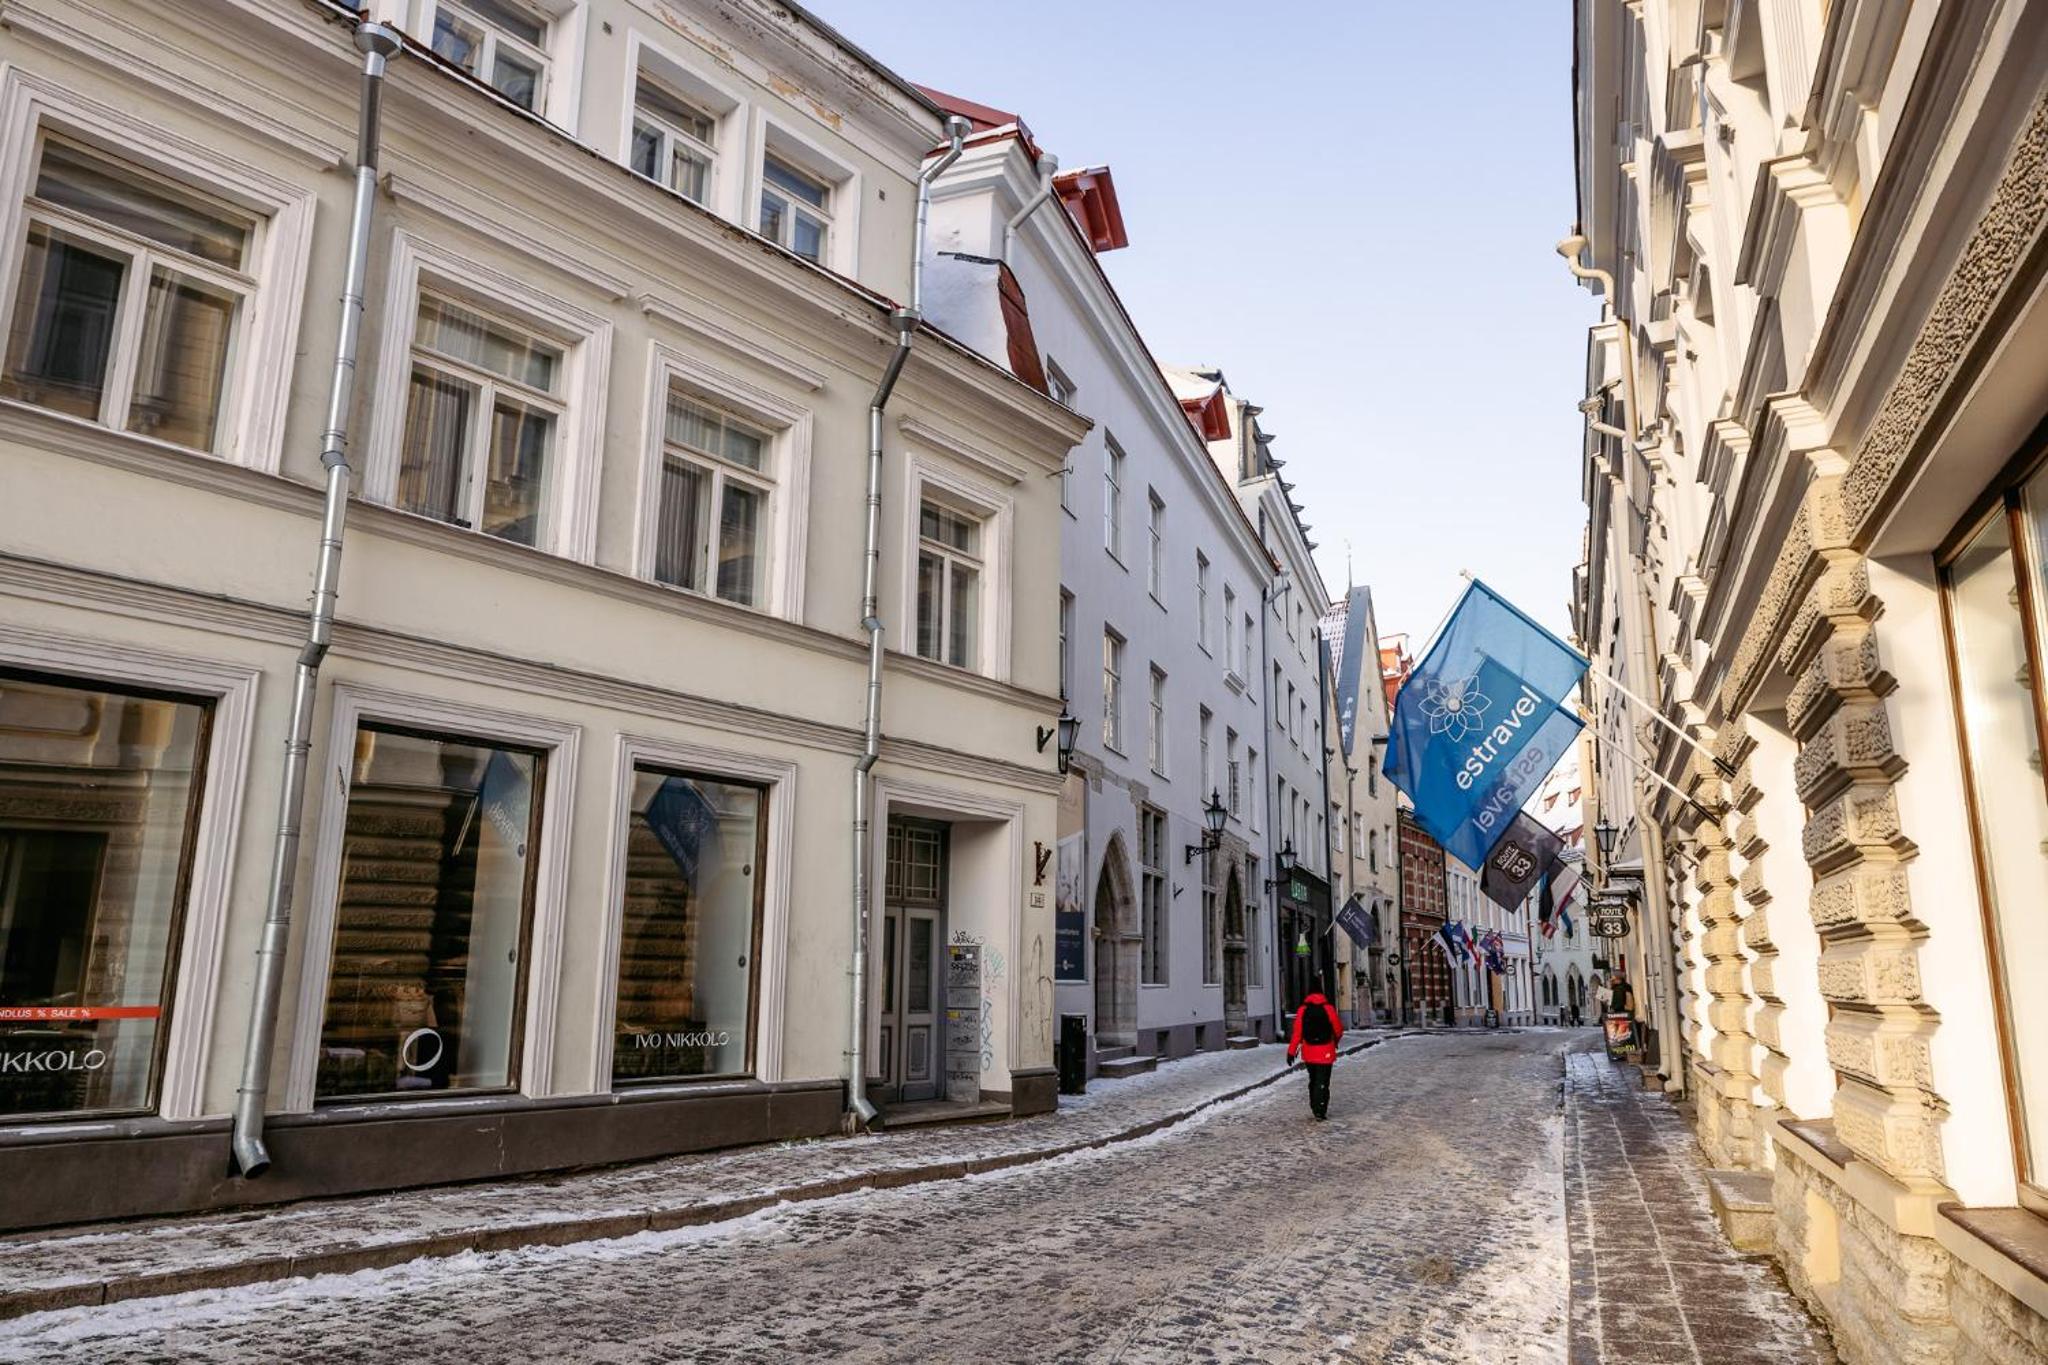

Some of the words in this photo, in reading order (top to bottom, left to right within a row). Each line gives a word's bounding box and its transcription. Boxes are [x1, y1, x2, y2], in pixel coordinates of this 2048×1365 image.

[1456, 685, 1542, 790] estravel
[1511, 858, 1531, 877] 33
[1605, 922, 1622, 935] 33
[50, 1009, 76, 1018] SALE
[635, 1033, 661, 1049] IVO
[665, 1031, 729, 1048] NIKKOLO
[0, 1050, 106, 1073] KKOLO
